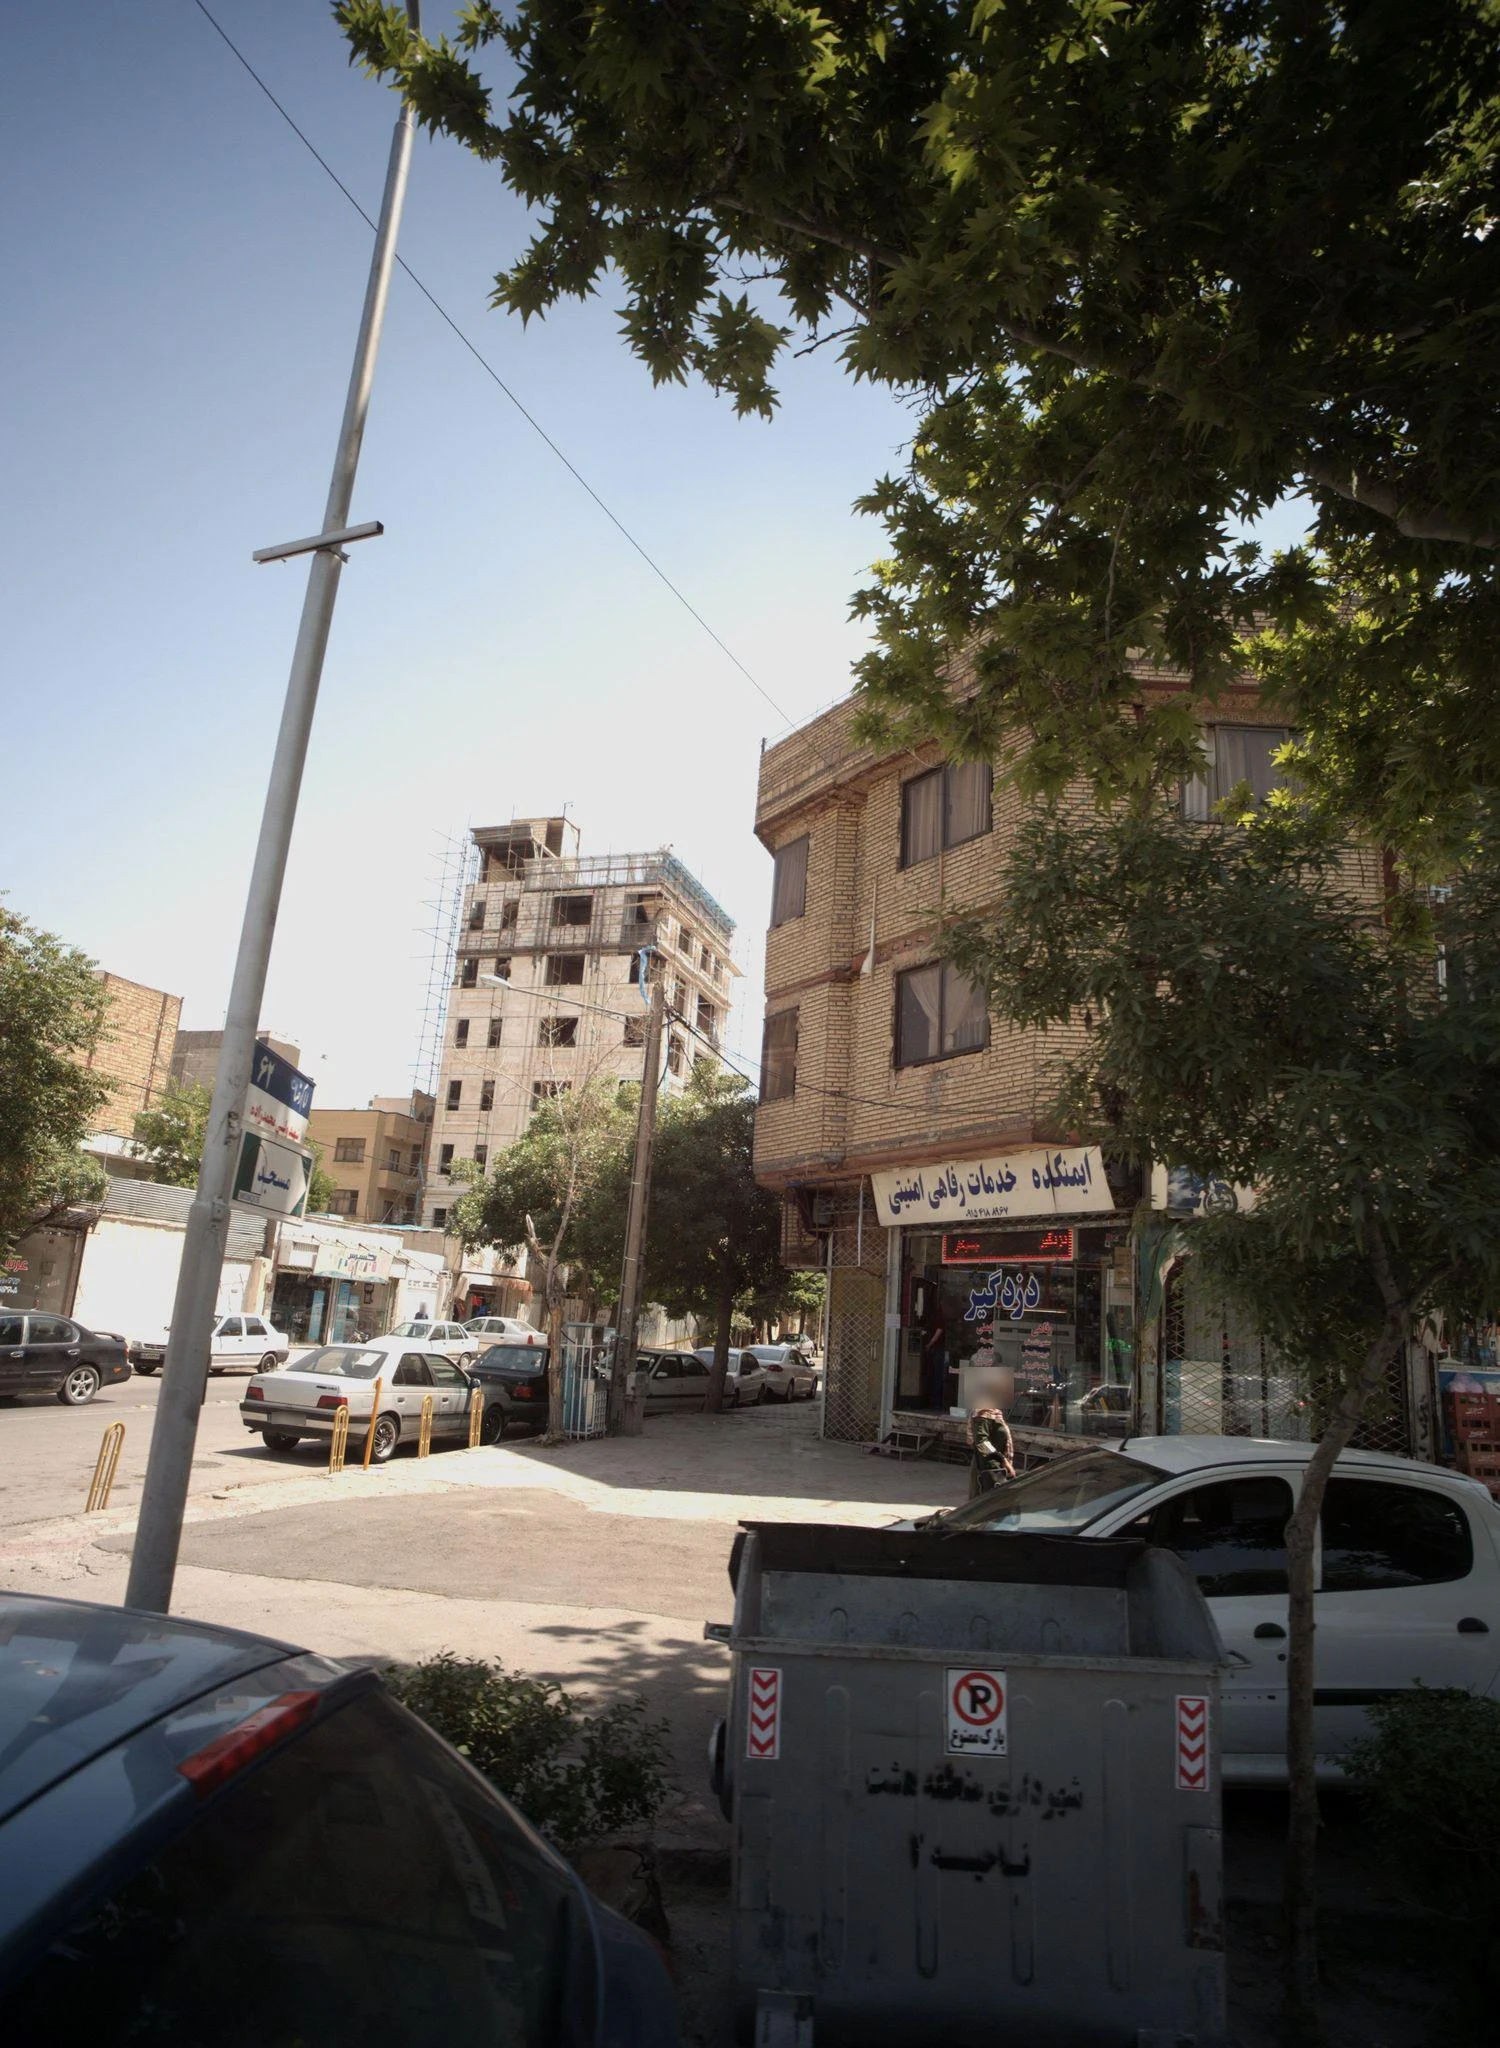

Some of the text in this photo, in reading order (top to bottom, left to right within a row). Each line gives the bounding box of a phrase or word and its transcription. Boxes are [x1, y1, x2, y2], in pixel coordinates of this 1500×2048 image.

[257, 1166, 290, 1194] مسجد
[888, 1173, 924, 1215] امنیتی
[928, 1165, 966, 1209] رفاهی
[967, 1161, 1017, 1196] خدمات
[963, 1269, 1041, 1321] دزدگیر
[969, 1685, 992, 1714] P
[951, 1728, 1005, 1751] پارک ممنوع
